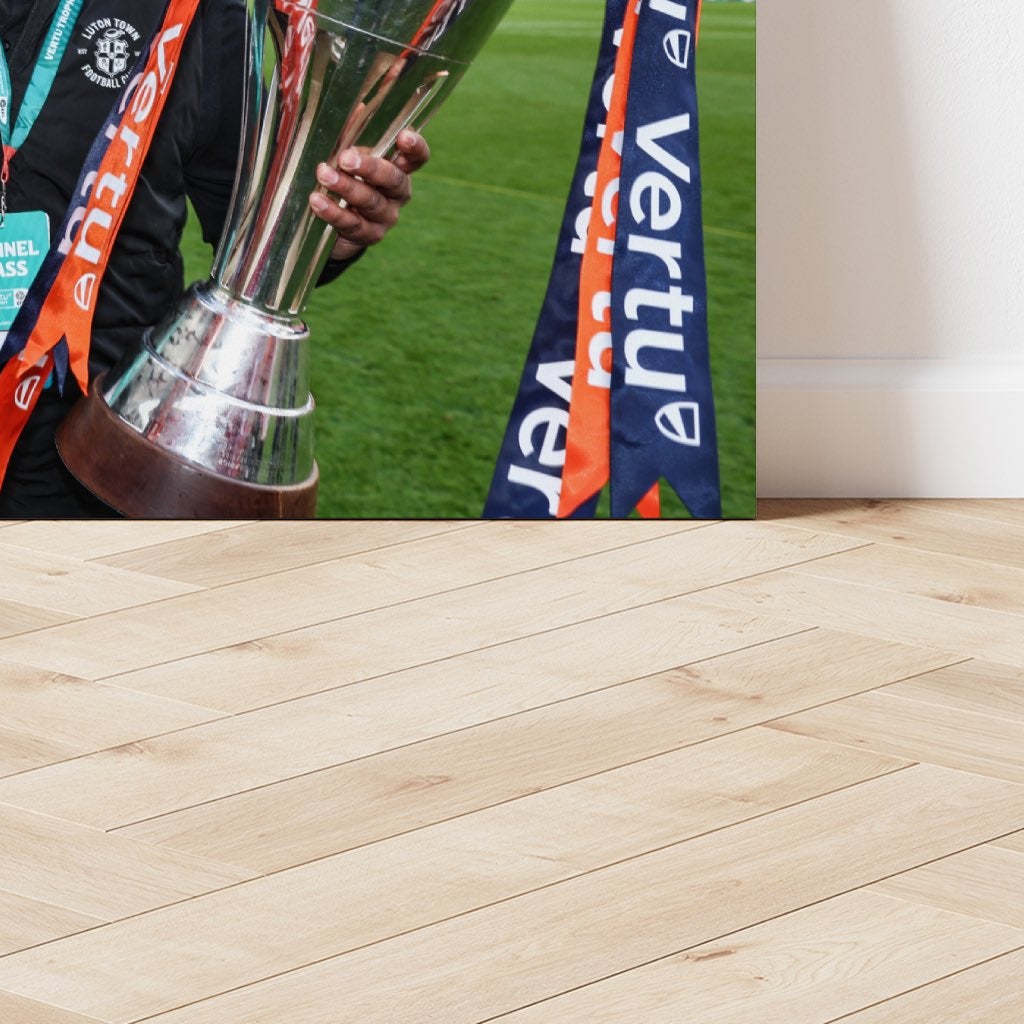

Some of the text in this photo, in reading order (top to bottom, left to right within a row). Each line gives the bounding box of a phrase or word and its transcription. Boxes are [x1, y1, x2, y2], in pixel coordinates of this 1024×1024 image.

[81, 17, 140, 41] LUTON TOWN
[45, 30, 63, 61] VERTU
[81, 64, 121, 88] FOOTBALL
[74, 23, 183, 265] Vertu
[623, 113, 694, 392] Vertu
